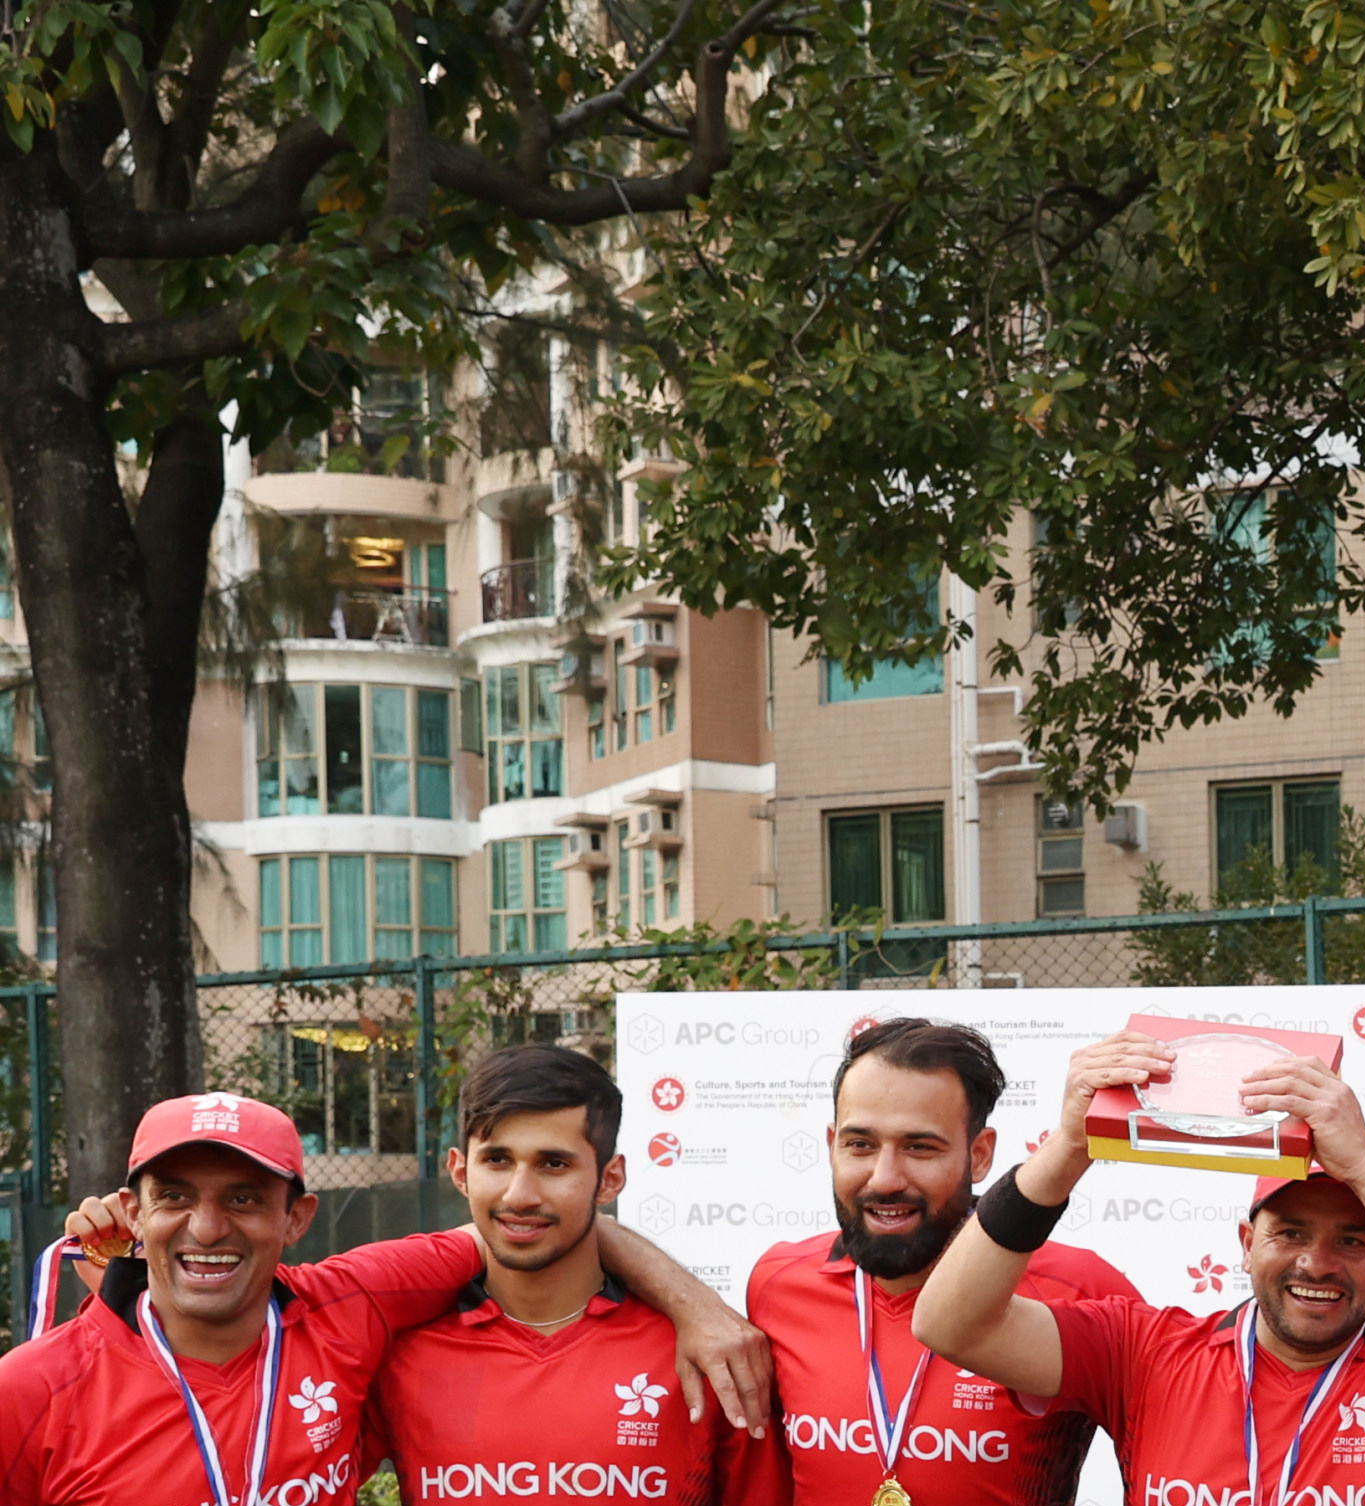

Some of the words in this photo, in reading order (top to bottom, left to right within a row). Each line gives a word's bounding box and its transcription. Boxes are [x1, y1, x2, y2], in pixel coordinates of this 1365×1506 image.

[674, 1022, 736, 1046] APC
[741, 1021, 819, 1049] Group
[989, 1020, 1027, 1029] Tourism
[1030, 1020, 1064, 1029] Bureau
[695, 1080, 732, 1090] Culture,
[735, 1080, 766, 1091] Sports
[768, 1080, 786, 1089] and
[789, 1080, 827, 1089] Tourism
[193, 1111, 240, 1122] CRICKET
[686, 1202, 747, 1226] APC
[752, 1202, 831, 1230] Group
[1102, 1198, 1164, 1222] APC
[954, 1383, 996, 1394] CRICKET
[306, 1416, 342, 1438] CRICKET
[617, 1420, 660, 1431] CRICKET
[783, 1413, 878, 1454] HONG
[902, 1424, 1009, 1463] ONG
[421, 1461, 540, 1499] HONG
[549, 1462, 668, 1499] KONG
